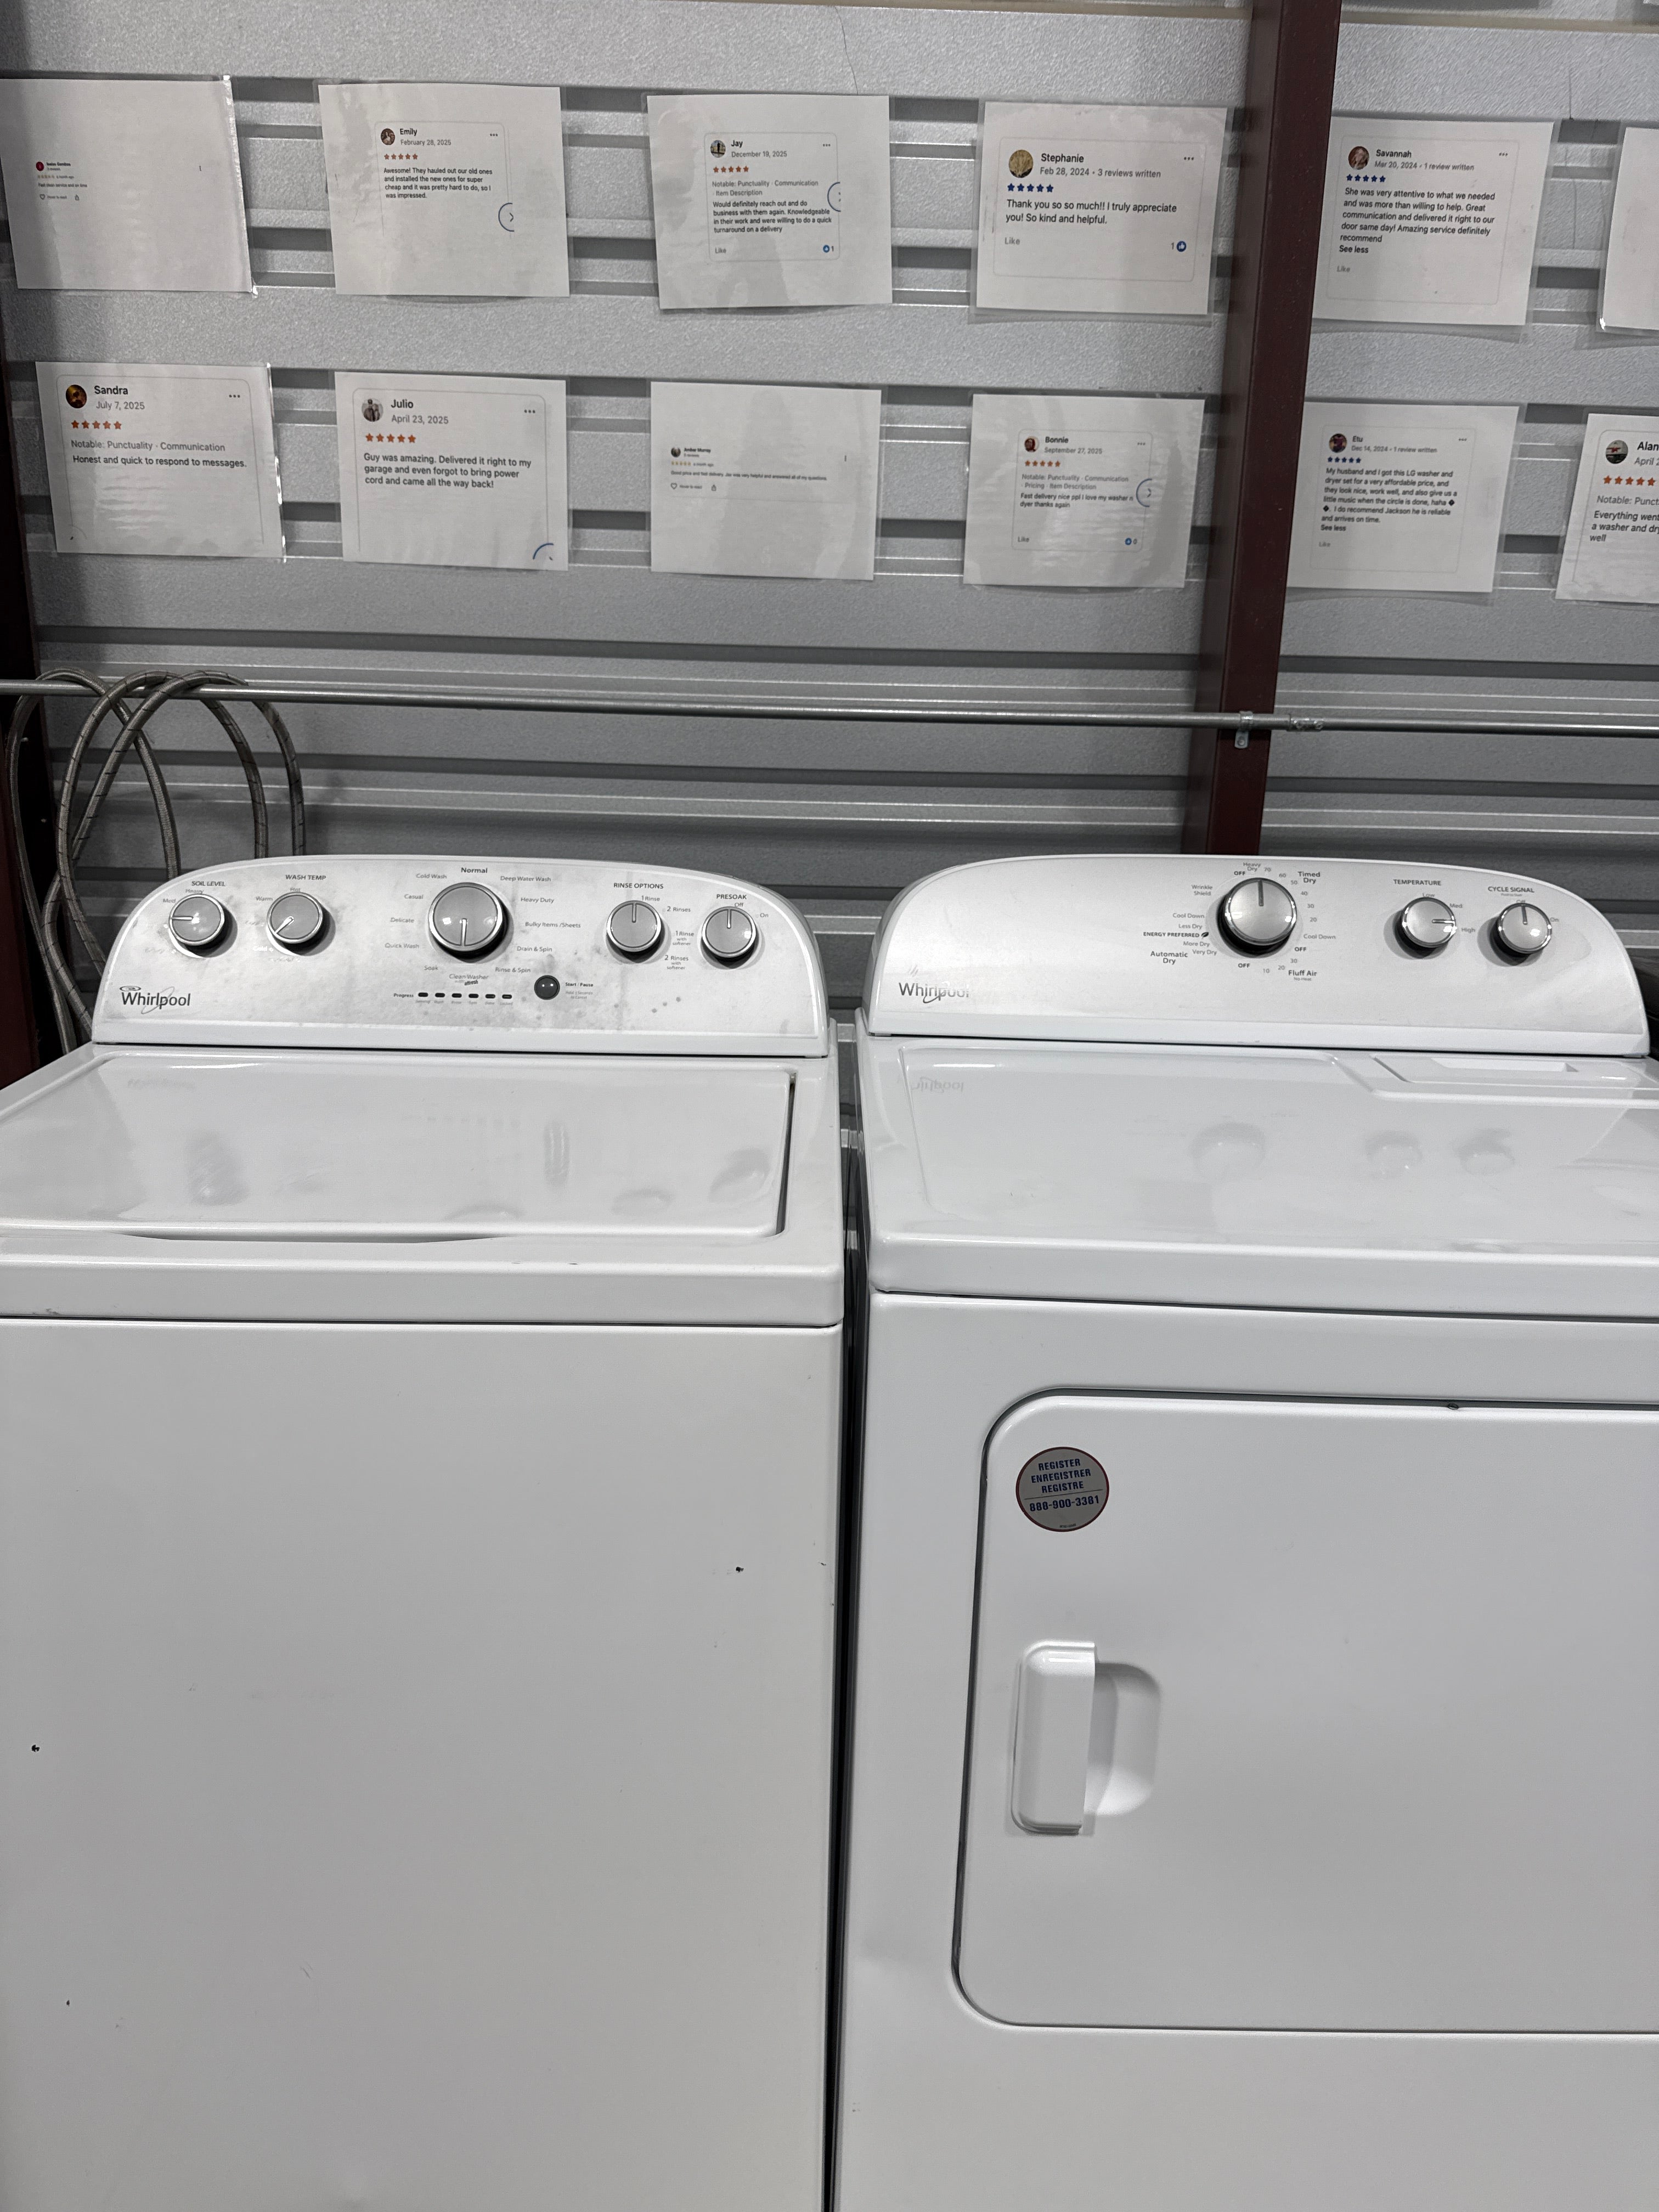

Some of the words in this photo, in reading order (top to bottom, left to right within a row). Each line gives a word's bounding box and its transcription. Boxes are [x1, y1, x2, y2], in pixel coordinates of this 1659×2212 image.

[399, 128, 417, 136] Emily
[731, 140, 743, 148] Jay
[1041, 153, 1084, 163] Stephanie
[1375, 149, 1411, 158] Savannah
[1388, 161, 1398, 169] 20,
[1040, 166, 1054, 174] Feb
[1056, 166, 1068, 177] 28,
[1070, 167, 1089, 176] 2024
[1097, 168, 1103, 176] 3
[1104, 168, 1133, 177] reviews
[1135, 169, 1161, 178] written
[1006, 199, 1032, 208] Thank
[1034, 201, 1049, 210] you
[1076, 201, 1105, 210] much!!
[1107, 201, 1109, 210] I
[1111, 202, 1130, 213] truly
[1132, 203, 1176, 213] appreciate
[1006, 213, 1023, 223] you!
[1025, 213, 1037, 222] So
[1039, 213, 1057, 222] kind
[1058, 214, 1074, 223] and
[1076, 215, 1107, 224] helpful.
[1005, 236, 1020, 245] Like
[1340, 234, 1383, 242] recommend
[1354, 245, 1368, 253] less
[94, 385, 128, 395] Sandra
[95, 400, 112, 410] July
[114, 401, 121, 410] 7,
[123, 401, 145, 410] 2025
[391, 399, 413, 408] Julio
[391, 414, 410, 424] April
[412, 415, 425, 425] 23,
[427, 415, 448, 424] 2025
[71, 439, 104, 448] Notable:
[107, 440, 153, 451] Punctuality
[160, 442, 225, 452] Communication
[1637, 441, 1659, 451] Alan
[72, 455, 101, 463] Honest
[120, 456, 143, 465] quick
[155, 458, 189, 466] respond
[202, 459, 246, 469] messages.
[364, 452, 380, 462] Guy
[400, 454, 436, 465] amazing.
[438, 455, 477, 465] Delivered
[479, 456, 484, 465] it
[487, 457, 506, 467] right
[508, 458, 517, 466] to
[518, 460, 531, 469] my
[1634, 457, 1654, 466] April
[364, 466, 392, 475] garage
[394, 465, 409, 473] and
[433, 466, 458, 477] forgot
[470, 467, 492, 478] bring
[494, 470, 519, 478] power
[365, 476, 383, 484] cord
[385, 476, 400, 484] and
[426, 478, 436, 486] all
[438, 478, 451, 487] the
[453, 480, 469, 489] way
[471, 479, 494, 488] back!
[1634, 496, 1659, 505] Punct
[1594, 510, 1638, 522] Everything
[898, 982, 969, 1002] Whirlpool
[120, 990, 191, 1011] Whirlpool
[1038, 1458, 1080, 1471] REGISTER
[1031, 1468, 1091, 1483] ENREGISTRER
[1041, 1481, 1084, 1493] REGISTRE
[1029, 1495, 1098, 1511] 888-900-3381
